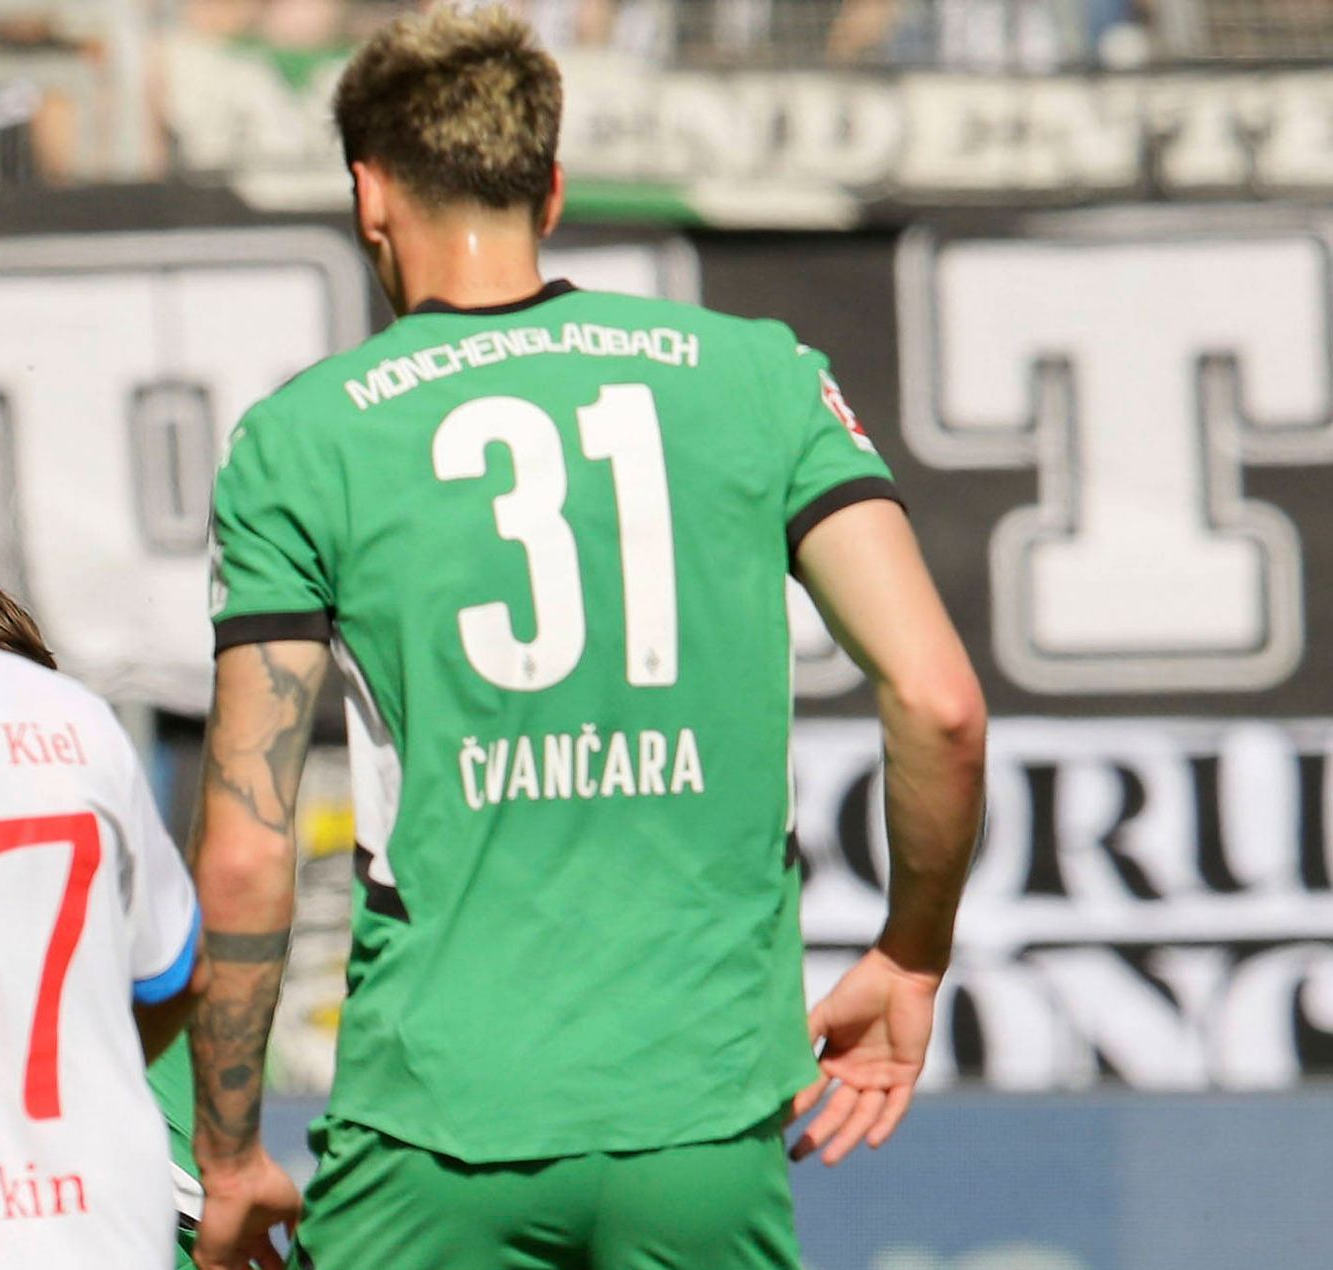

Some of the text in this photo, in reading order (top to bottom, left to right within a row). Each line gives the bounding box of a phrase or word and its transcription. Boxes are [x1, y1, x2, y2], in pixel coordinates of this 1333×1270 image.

[344, 323, 699, 410] MÖNCHENGLADBACH
[432, 382, 679, 692] 31
[0, 721, 88, 768] Kiel
[459, 723, 704, 811] ČVANČARA
